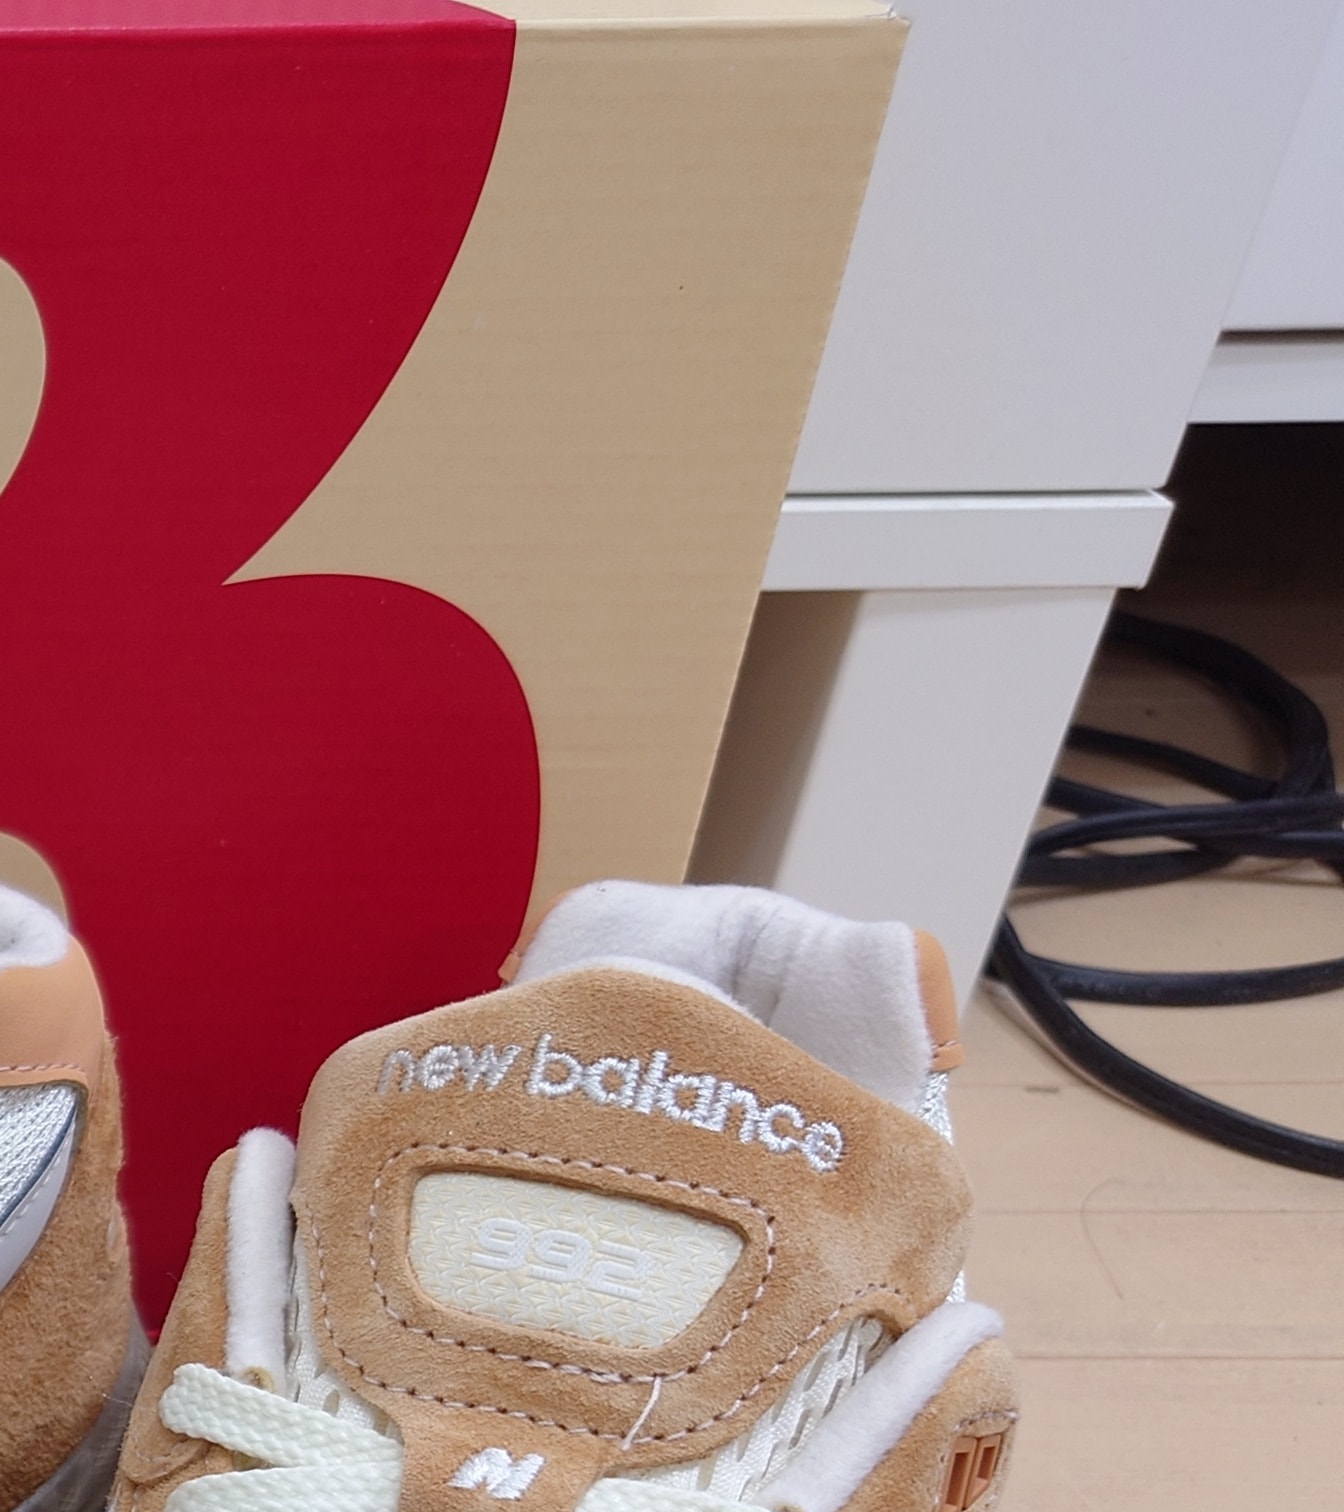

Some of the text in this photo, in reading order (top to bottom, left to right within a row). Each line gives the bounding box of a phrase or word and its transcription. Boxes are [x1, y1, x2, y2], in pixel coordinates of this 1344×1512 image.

[376, 1032, 844, 1173] new balance
[468, 1216, 653, 1302] 992
